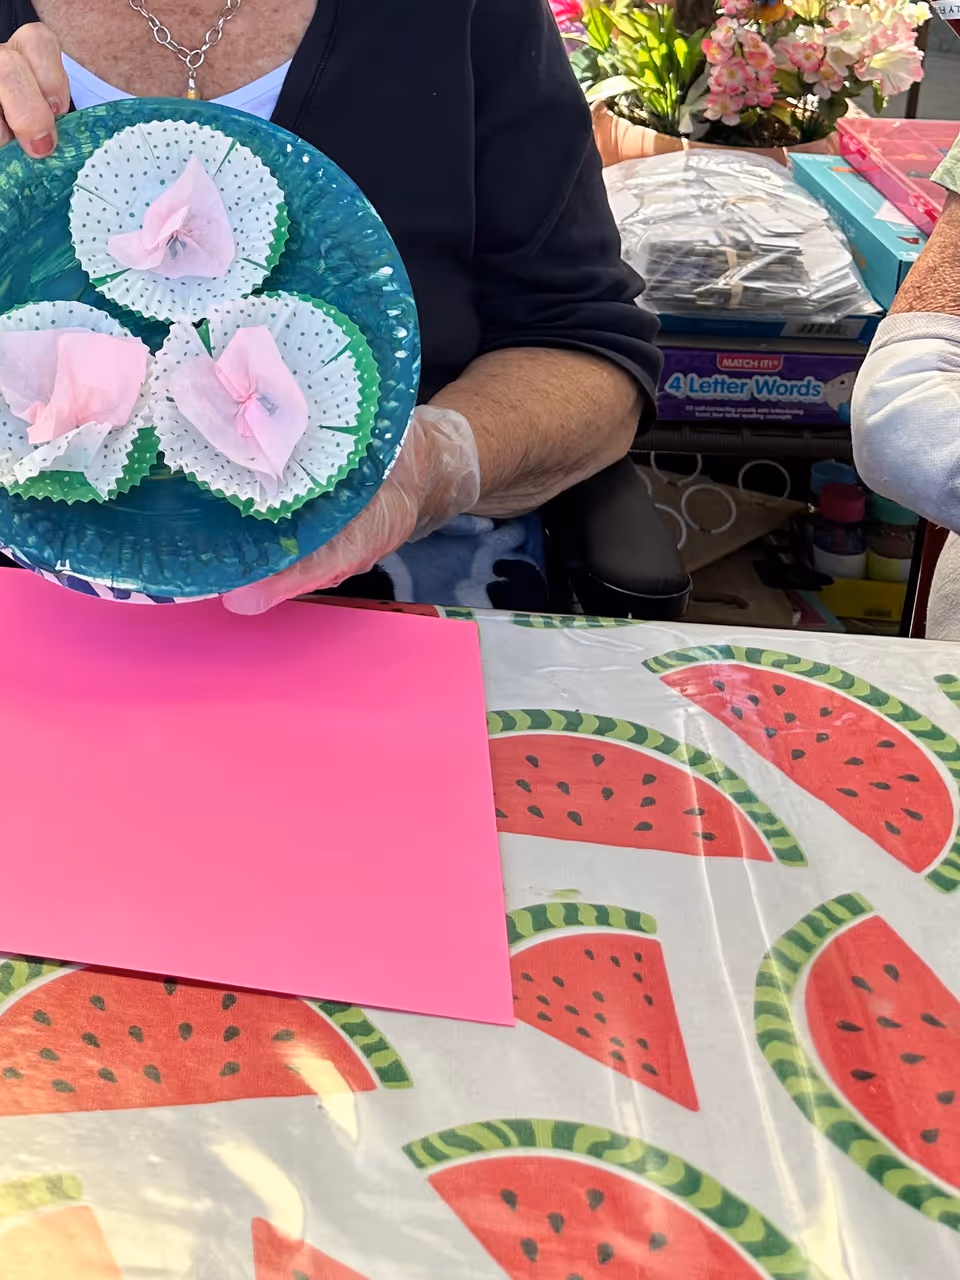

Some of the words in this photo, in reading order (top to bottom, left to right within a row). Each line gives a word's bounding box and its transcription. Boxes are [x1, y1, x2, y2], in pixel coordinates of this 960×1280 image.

[721, 357, 758, 368] MATCH
[667, 375, 683, 394] 4
[689, 375, 748, 395] Letter
[754, 378, 822, 398] Words
